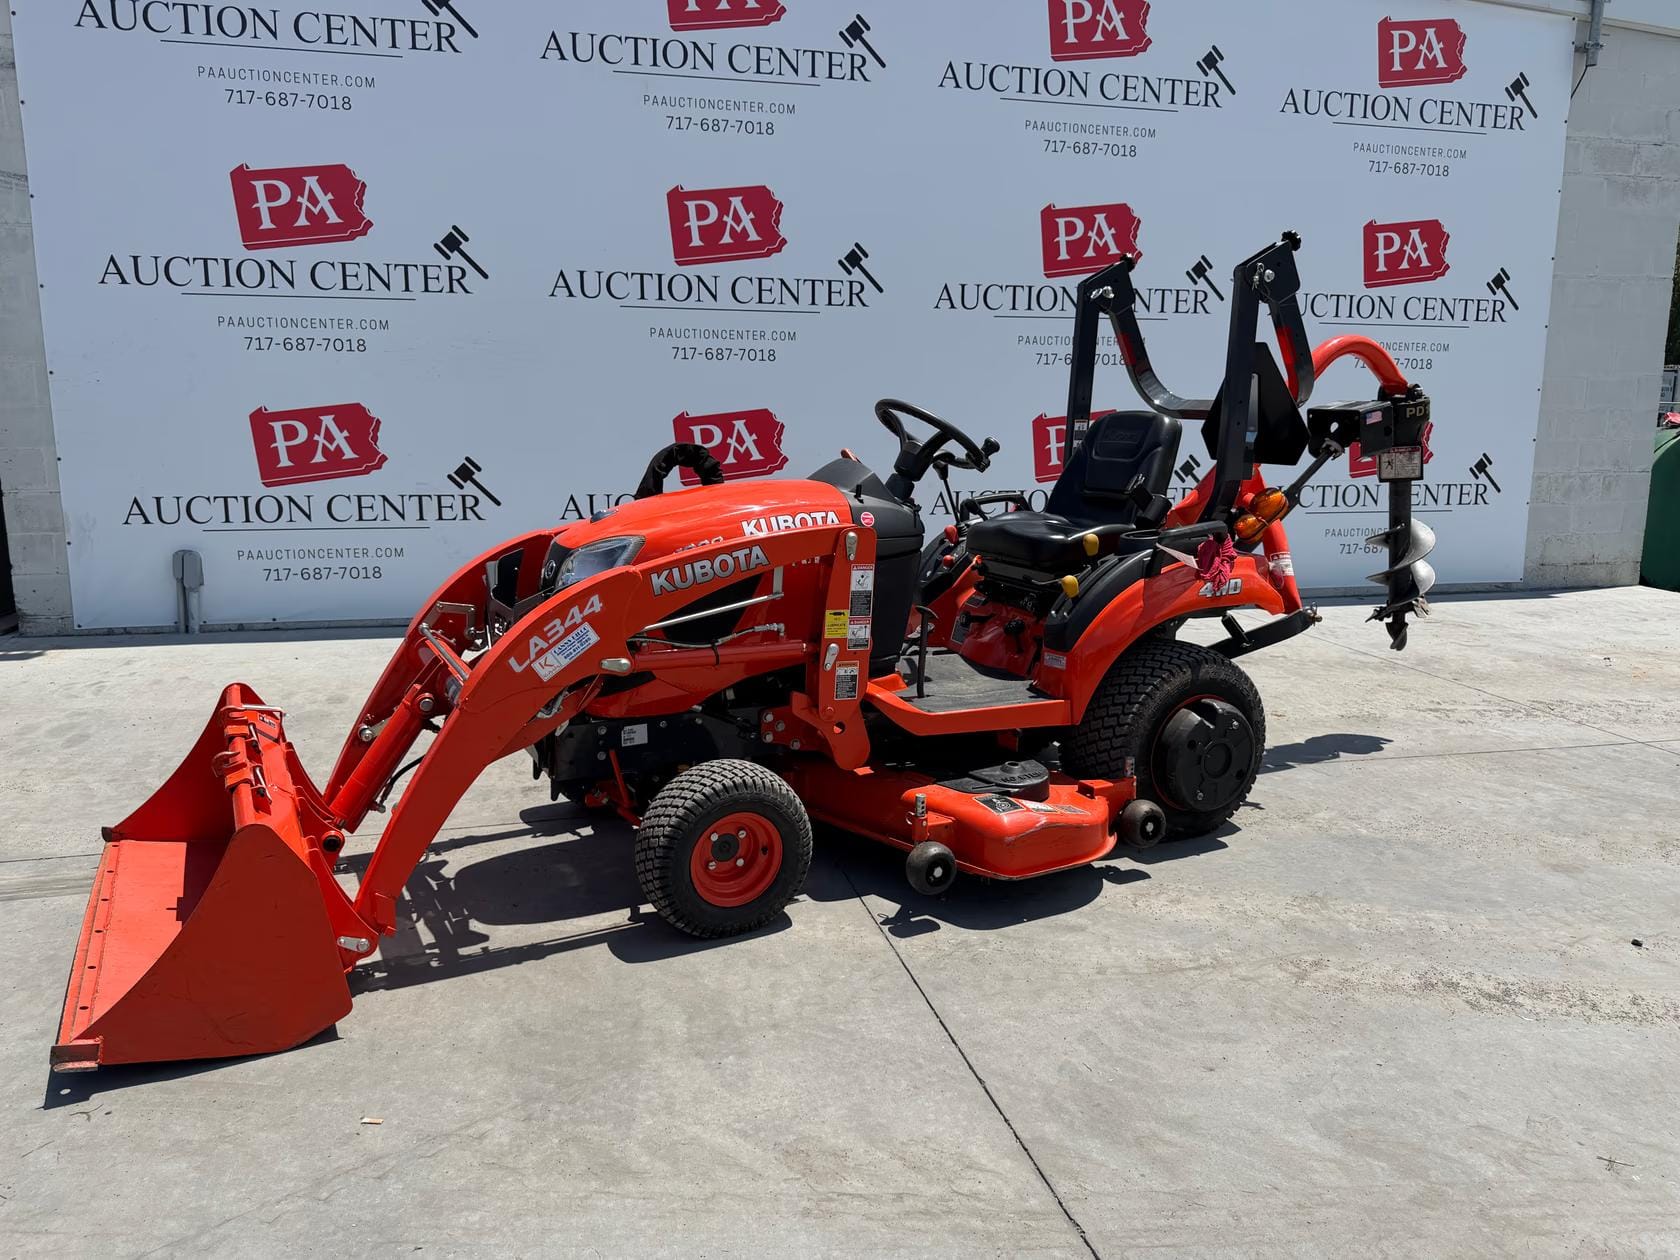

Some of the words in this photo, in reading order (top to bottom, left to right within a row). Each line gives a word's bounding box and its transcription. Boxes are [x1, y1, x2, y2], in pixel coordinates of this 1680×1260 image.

[73, 0, 280, 41] AUCTION
[293, 11, 463, 54] CENTER
[1061, 0, 1130, 44] PA
[539, 29, 717, 72] AUCTION
[727, 43, 872, 83] CENTER
[1389, 27, 1448, 71] PA
[197, 65, 376, 89] PAAUCTIONCENTER.COM
[937, 60, 1091, 99] AUCTION
[1099, 73, 1223, 109] CENTER
[224, 88, 353, 111] 717-687-7018
[642, 94, 796, 115] PAAUCTIONCENTER.COM
[1279, 87, 1413, 123] AUCTION
[1419, 98, 1525, 131] CENTER
[665, 115, 775, 136] 717-687-7018
[1024, 119, 1156, 139] PAAUCTIONCENTER.COM
[1043, 139, 1137, 158] 717-687-7018
[1353, 141, 1467, 159] PAAUCTIONCENTER.COM
[1368, 159, 1450, 178] 717-687-7018
[250, 175, 344, 230] PA
[684, 196, 762, 247] PA
[1054, 213, 1121, 260] PA
[1374, 228, 1431, 272] PA
[98, 254, 297, 290] AUCTION
[309, 260, 473, 295] CENTER
[548, 268, 721, 303] AUCTION
[730, 275, 870, 308] CENTER
[934, 283, 1078, 312] AUCTION
[1132, 287, 1212, 315] NTER
[1298, 292, 1396, 320] CTION
[1403, 296, 1507, 323] CENTER
[217, 315, 390, 331] PAAUCTIONCENTER.COM
[649, 327, 797, 342] PAAUCTIONCENTER.COM
[243, 336, 367, 353] 717-687-7018
[671, 346, 777, 362] 717-687-7018
[268, 414, 359, 468] PA
[121, 494, 314, 526] AUCTION
[326, 494, 487, 523] CENTER
[1299, 483, 1381, 508] CTION
[1410, 483, 1490, 507] ENTER
[741, 511, 841, 537] KUBOTA
[236, 547, 405, 561] PAAUCTIONCENTER.COM
[262, 565, 383, 582] 717-687-7018
[650, 544, 770, 596] KUBOTA
[508, 594, 603, 673] LA344
